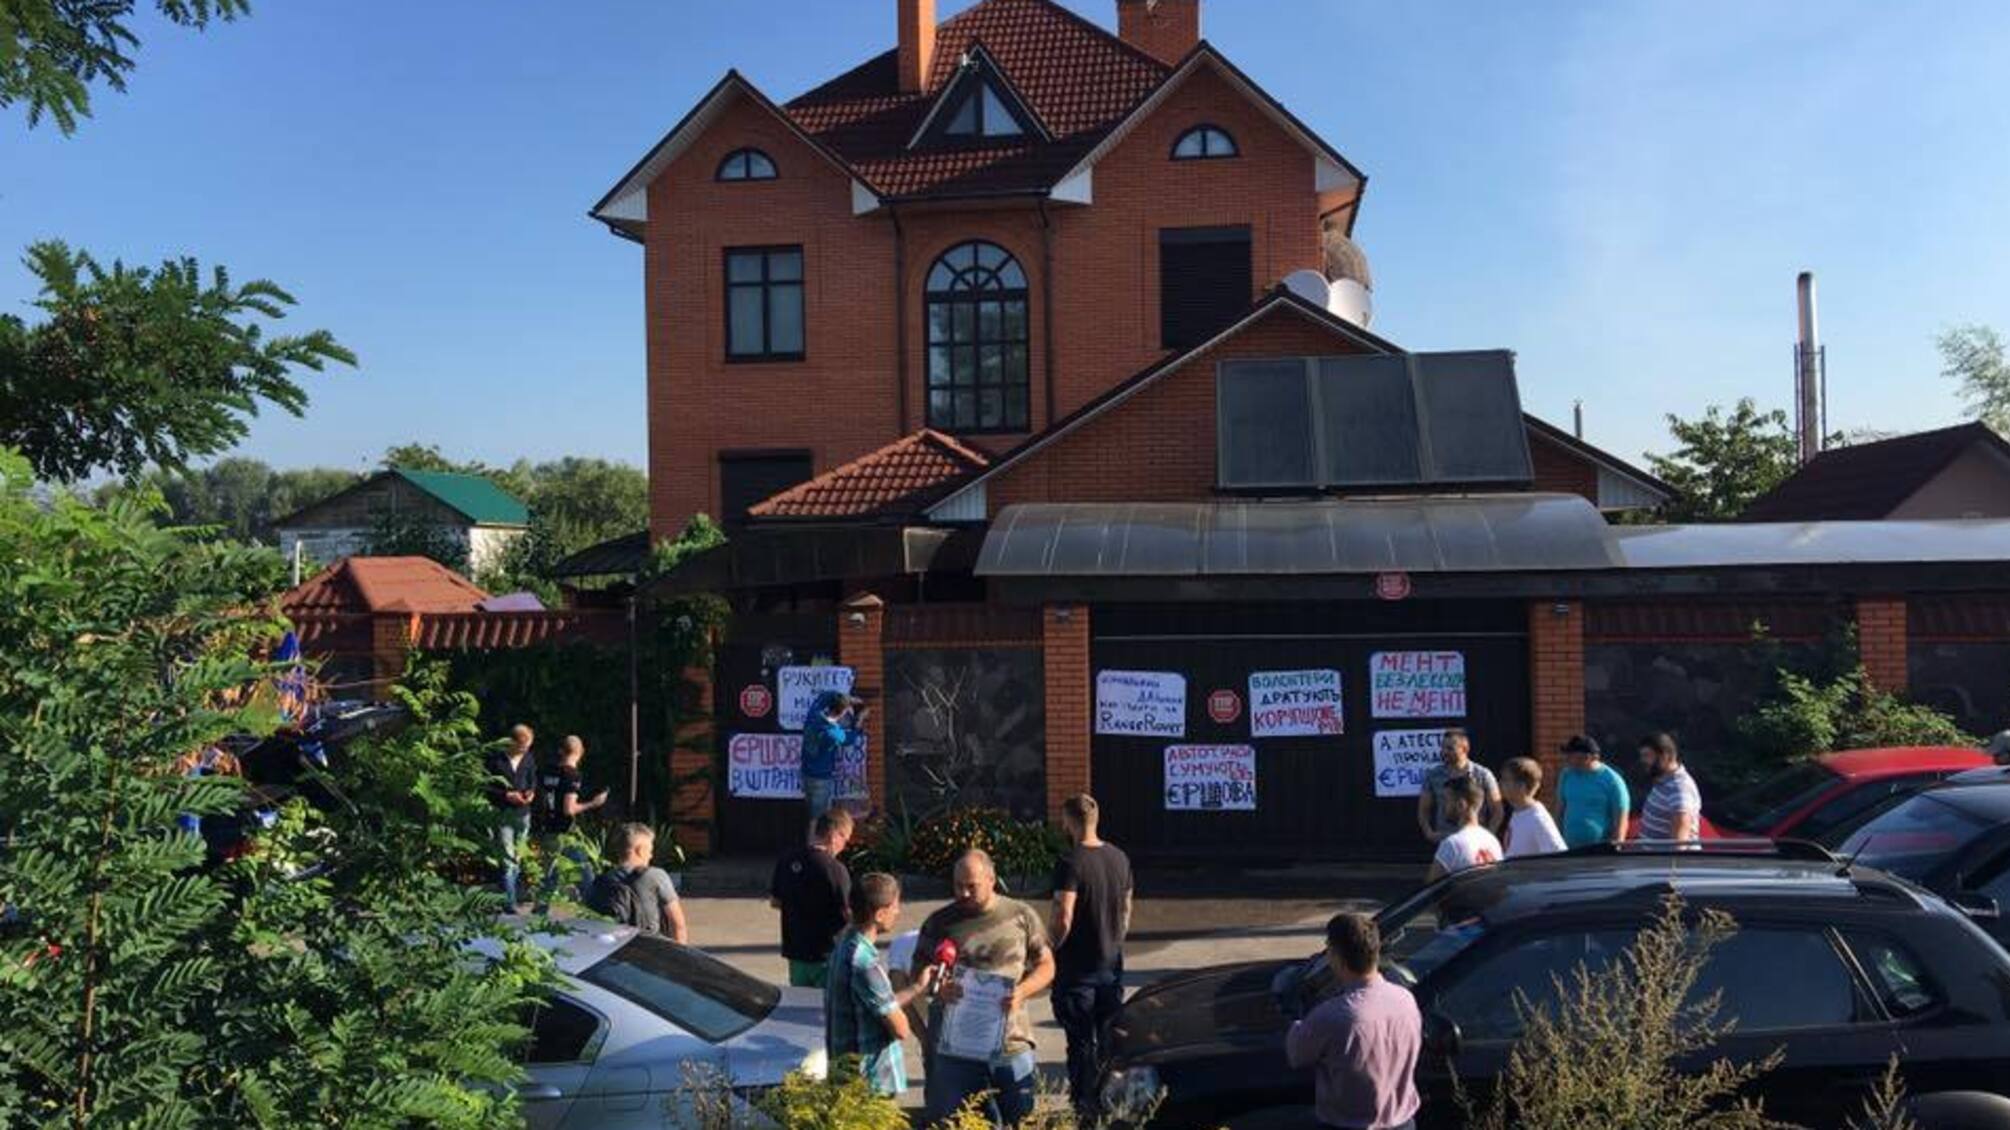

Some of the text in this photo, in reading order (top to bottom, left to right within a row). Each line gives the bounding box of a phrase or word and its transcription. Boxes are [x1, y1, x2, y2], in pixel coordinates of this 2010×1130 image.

[1380, 652, 1457, 672] МЕНТ
[1377, 690, 1405, 710] НЕ
[1399, 732, 1443, 749] АТЕСТ
[733, 737, 801, 766] ЄРШОВ
[1378, 767, 1425, 788] ЄРШ
